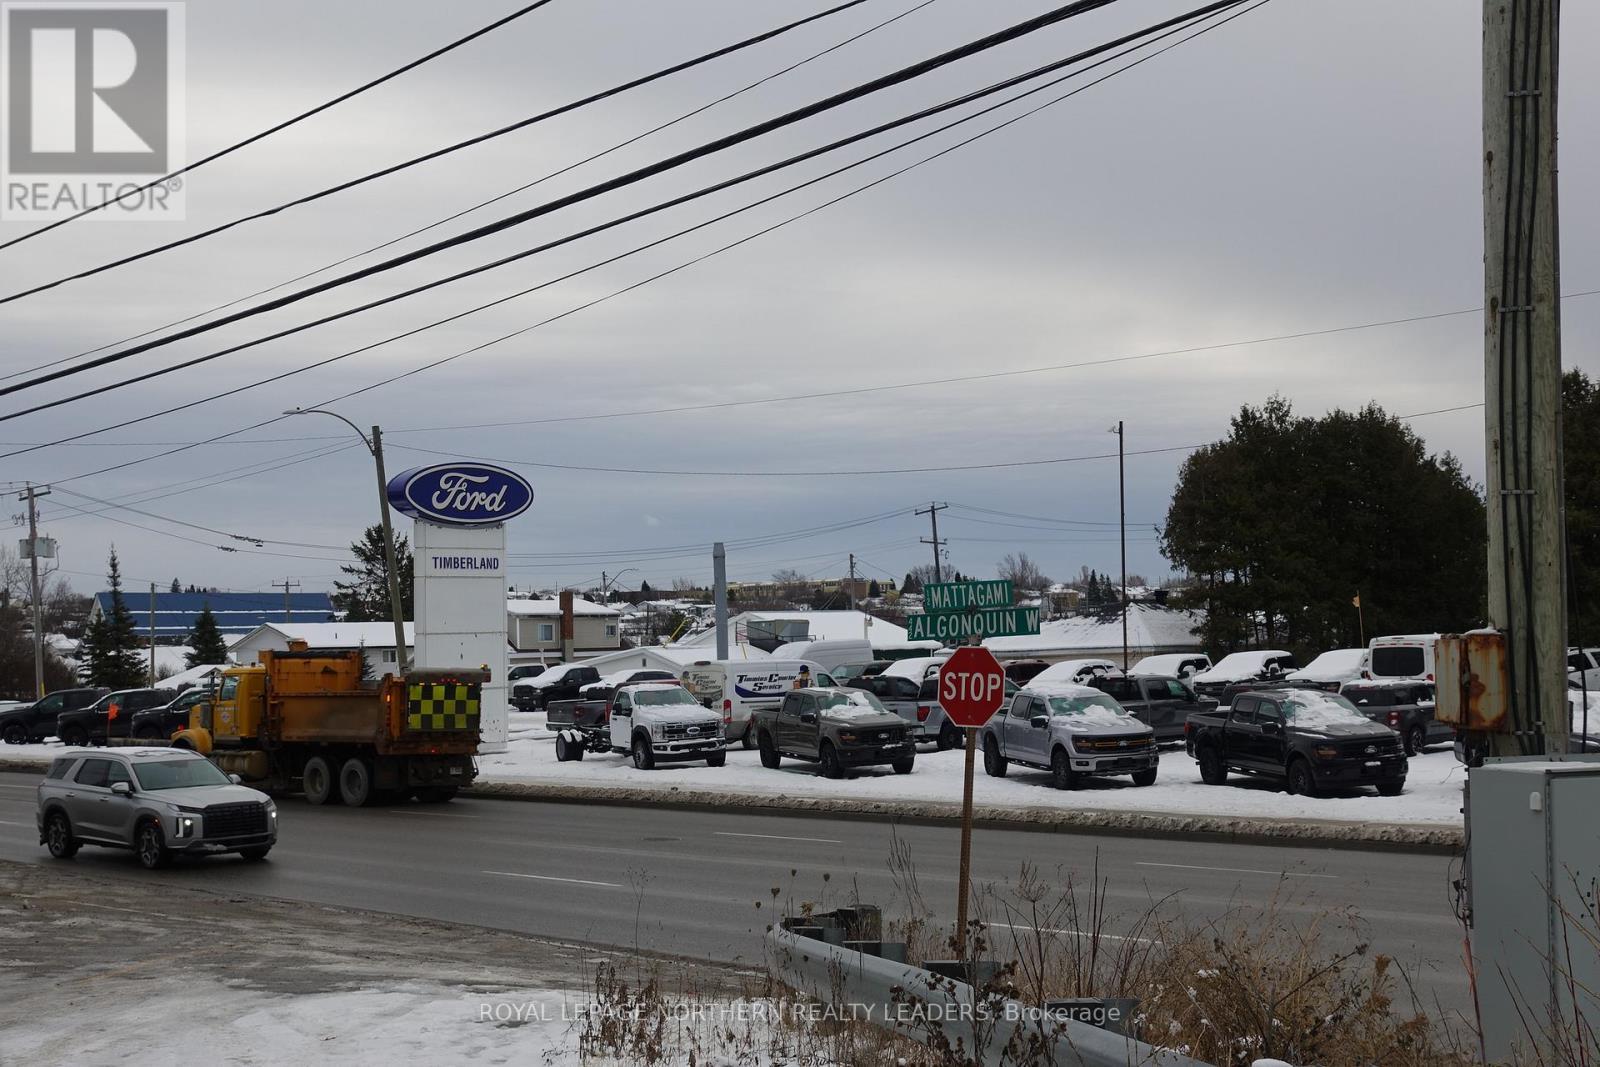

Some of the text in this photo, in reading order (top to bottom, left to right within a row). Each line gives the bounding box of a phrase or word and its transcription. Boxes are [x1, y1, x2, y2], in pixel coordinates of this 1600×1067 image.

[431, 472, 508, 512] Ford
[432, 556, 499, 570] TIMBERLAND
[931, 582, 1009, 609] MATTAGAMI
[913, 609, 1039, 638] ALGONQUIN W
[943, 671, 1002, 703] STOP
